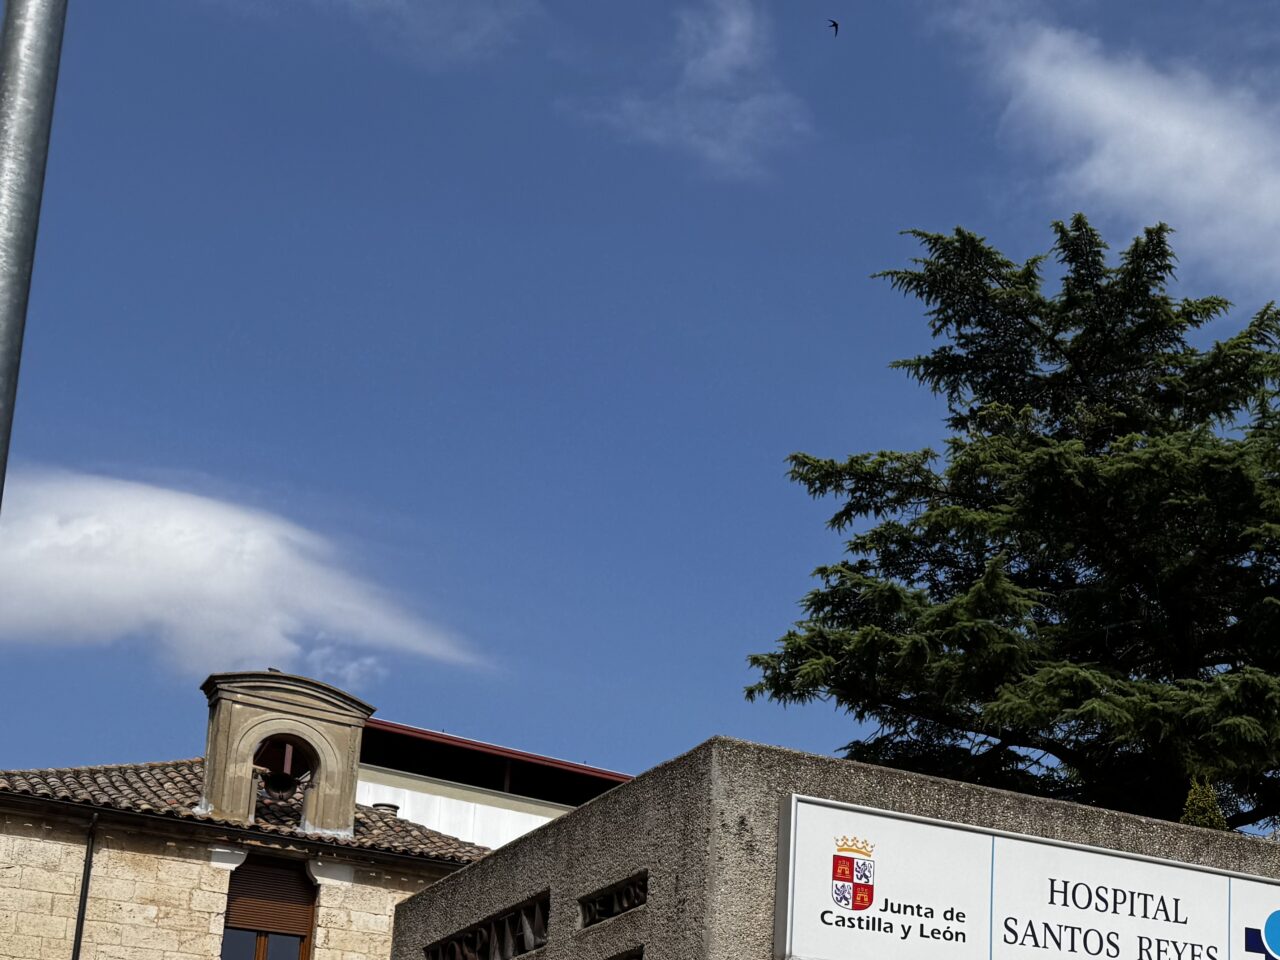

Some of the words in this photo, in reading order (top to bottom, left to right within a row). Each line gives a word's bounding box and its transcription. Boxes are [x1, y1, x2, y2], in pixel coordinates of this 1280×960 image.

[879, 898, 935, 919] Junta
[943, 907, 967, 923] de
[1048, 878, 1189, 925] HOSPITAL
[820, 910, 894, 934] Castilla
[900, 923, 912, 940] y
[919, 922, 967, 943] León
[1003, 917, 1121, 959] SANTOS
